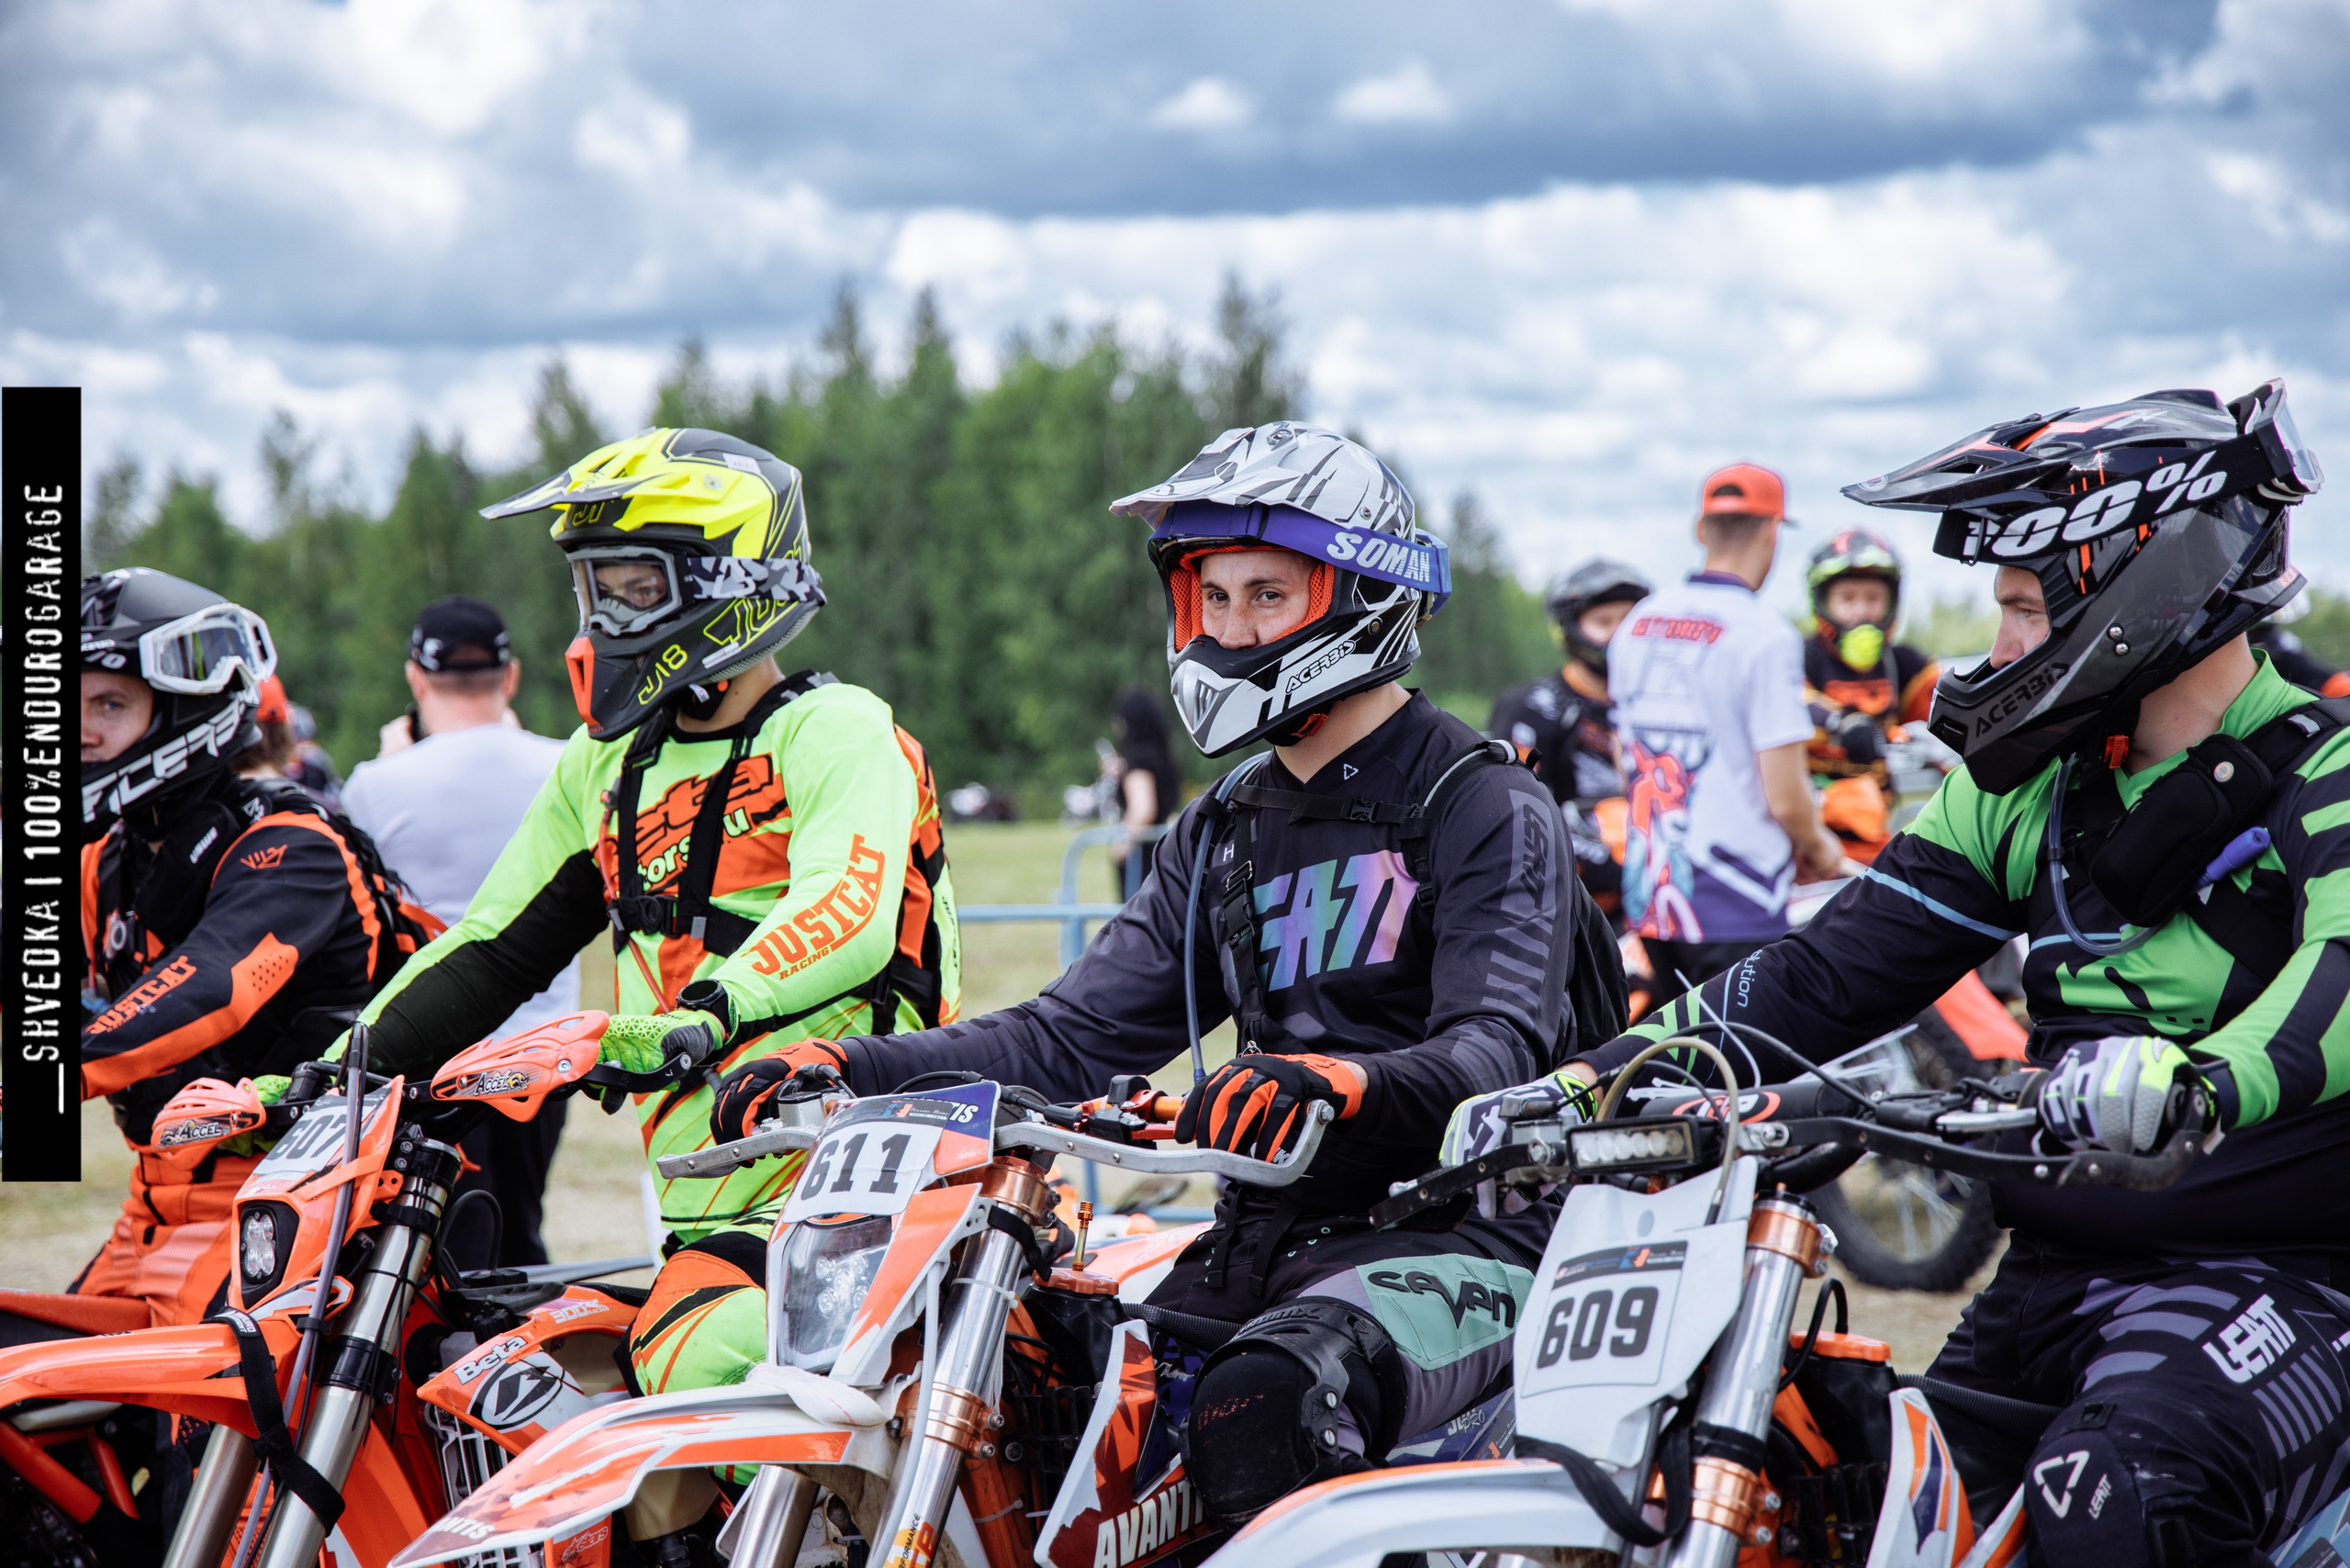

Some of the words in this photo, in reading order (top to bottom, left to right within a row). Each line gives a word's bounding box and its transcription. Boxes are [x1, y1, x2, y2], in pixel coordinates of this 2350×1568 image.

[1326, 531, 1431, 583] SOMAN
[741, 833, 885, 976] JUSTCAT
[1253, 848, 1421, 992] EATT
[778, 946, 830, 981] RACING
[800, 1132, 912, 1202] 611
[453, 1336, 528, 1386] Beta
[1536, 1285, 1660, 1371] 609
[2202, 1293, 2297, 1384] LEATT
[1093, 1479, 1203, 1568] AVANTI
[2087, 1473, 2112, 1520] LEATT
